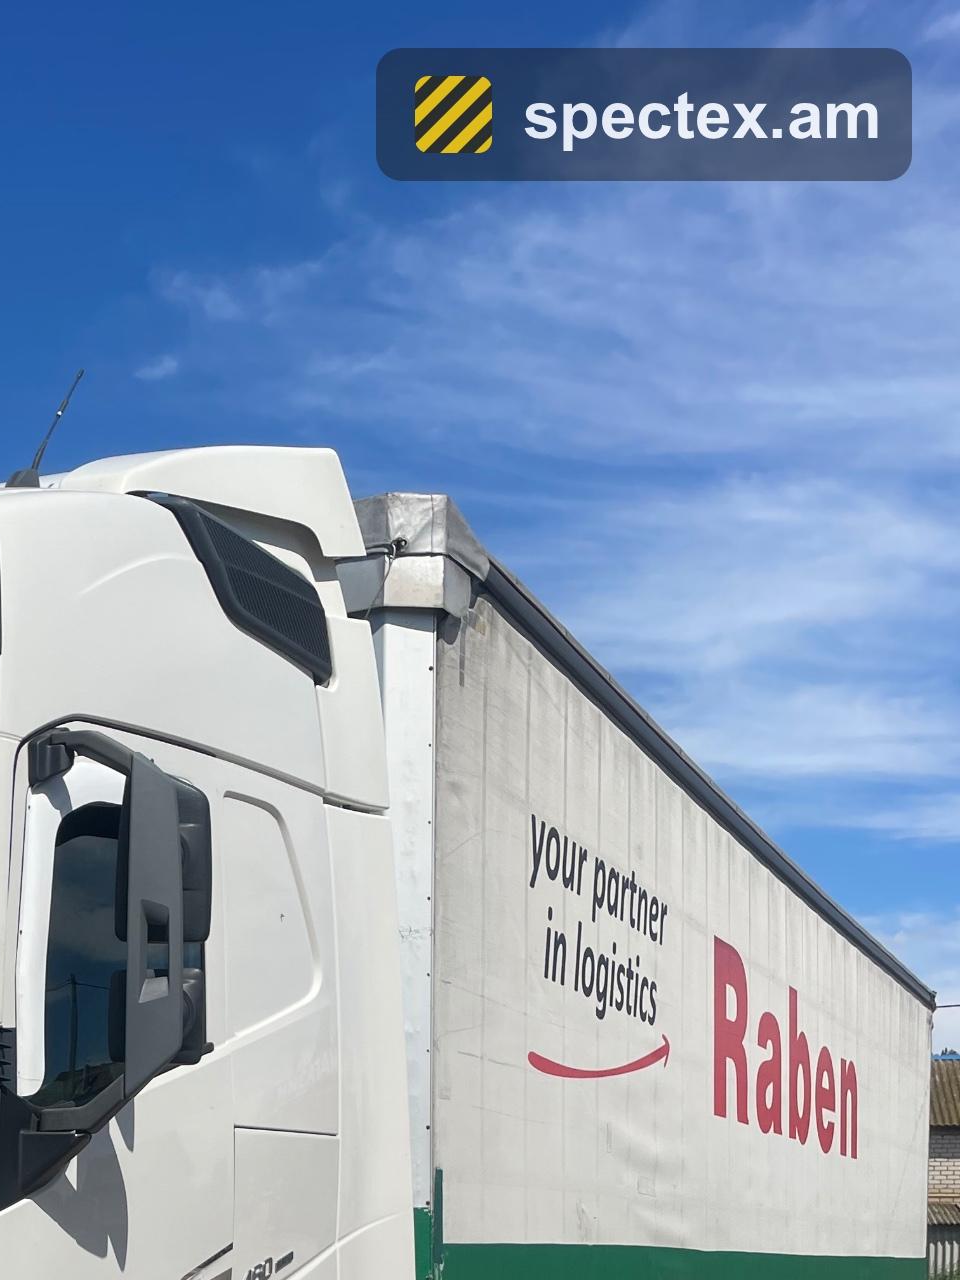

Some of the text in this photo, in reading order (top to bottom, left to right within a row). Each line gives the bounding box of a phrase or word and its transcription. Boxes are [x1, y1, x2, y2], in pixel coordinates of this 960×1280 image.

[528, 813, 668, 945] your partner
[543, 906, 658, 1026] in logistics
[713, 934, 859, 1160] Raben
